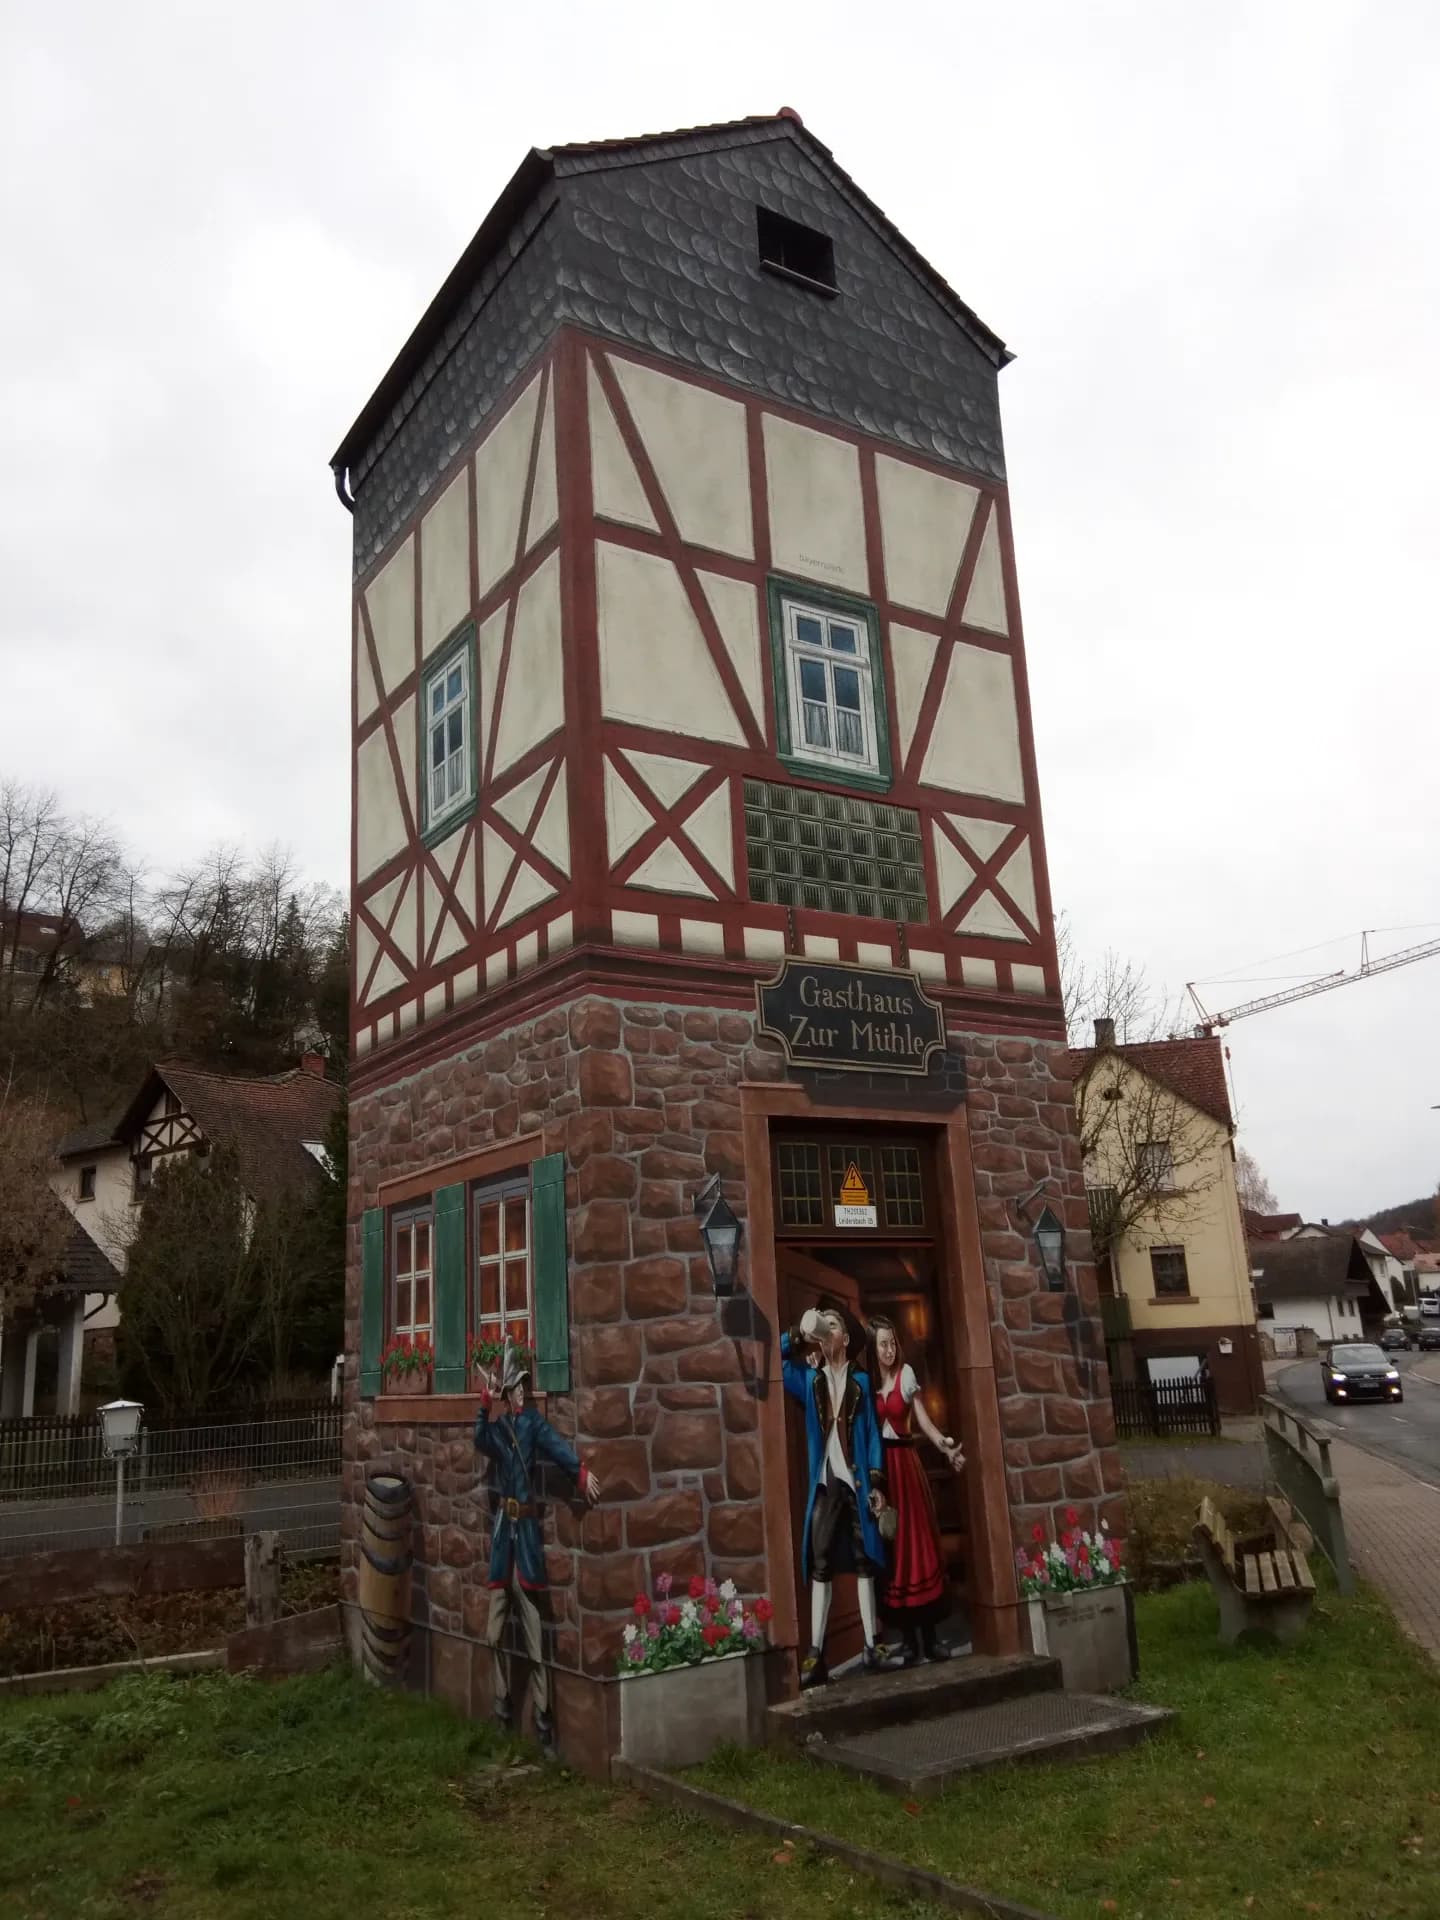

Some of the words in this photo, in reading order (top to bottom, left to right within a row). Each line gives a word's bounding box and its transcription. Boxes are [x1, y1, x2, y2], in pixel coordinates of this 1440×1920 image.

[799, 975, 913, 1015] Gasthaus
[789, 1014, 839, 1048] Zur
[850, 1019, 925, 1055] Mühle
